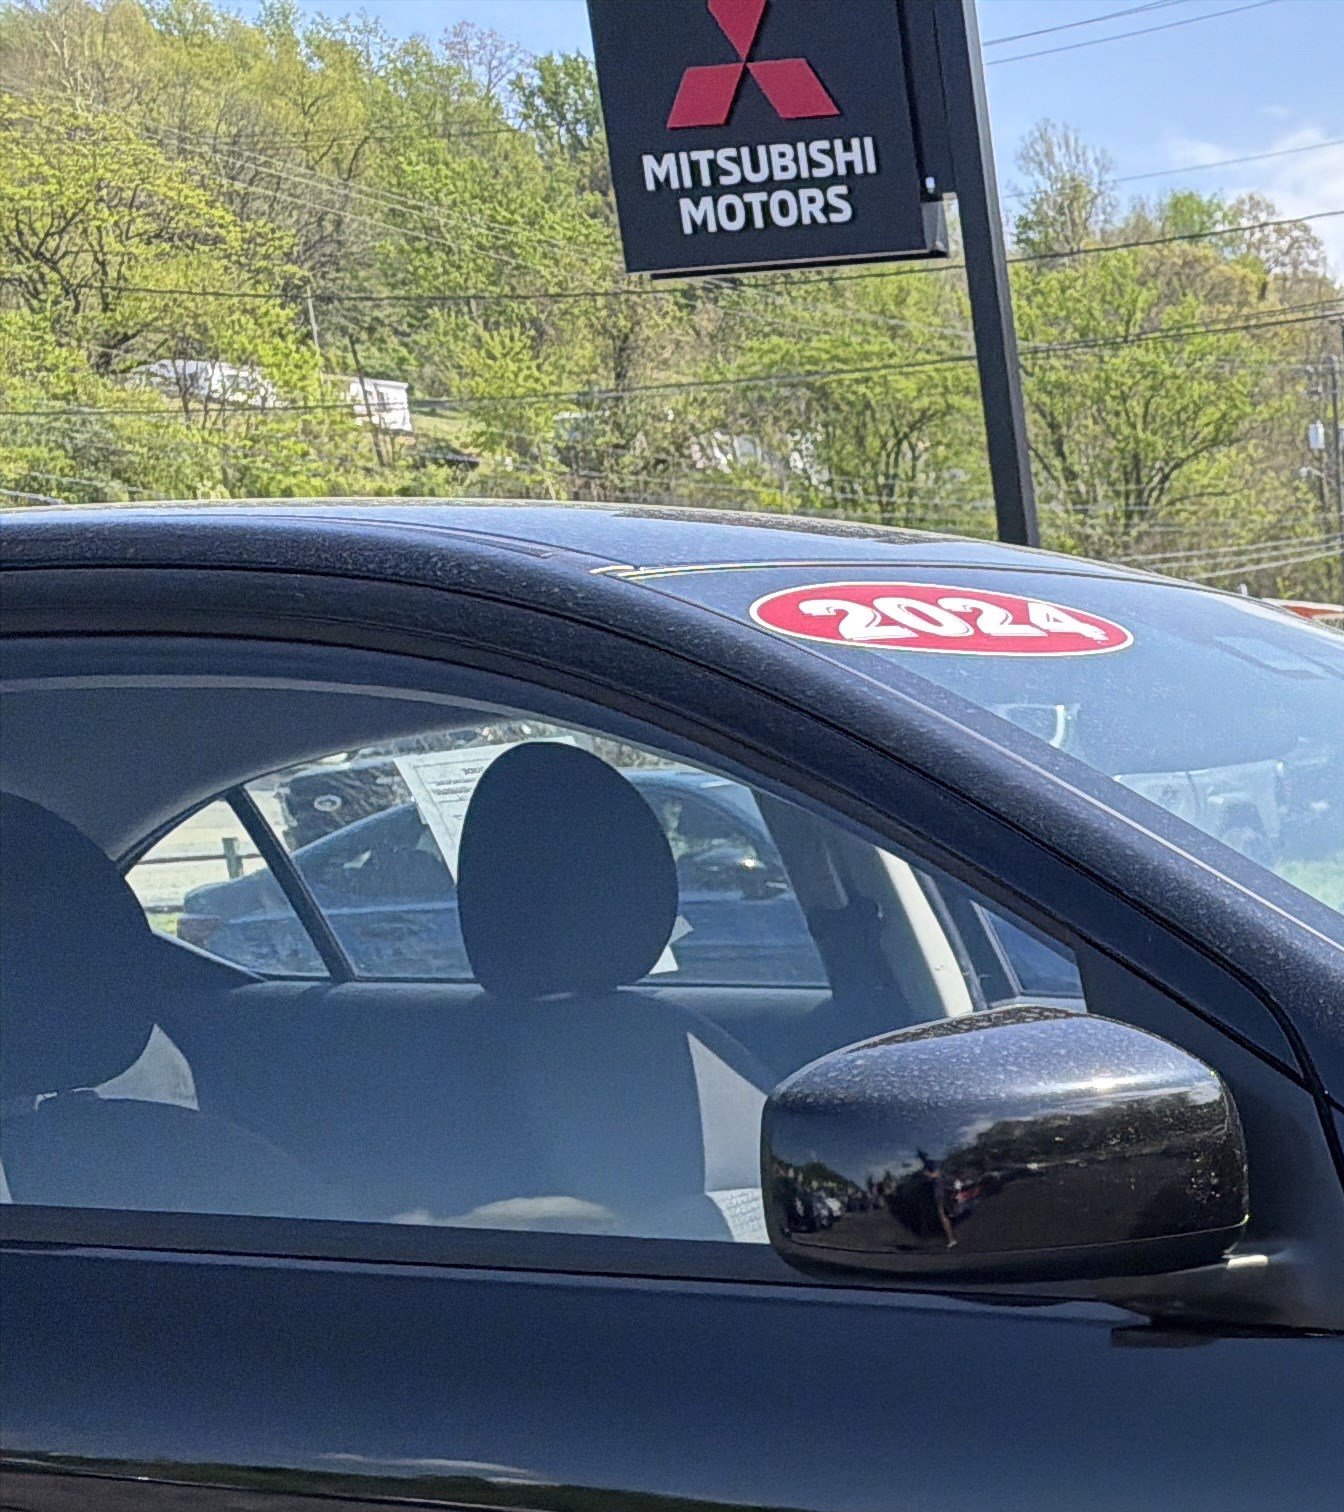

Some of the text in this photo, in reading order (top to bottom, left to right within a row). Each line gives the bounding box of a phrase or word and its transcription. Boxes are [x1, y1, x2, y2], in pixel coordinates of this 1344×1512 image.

[642, 137, 877, 191] MITSUBISHI
[679, 185, 853, 235] MOTORS
[799, 597, 1109, 641] 2024
